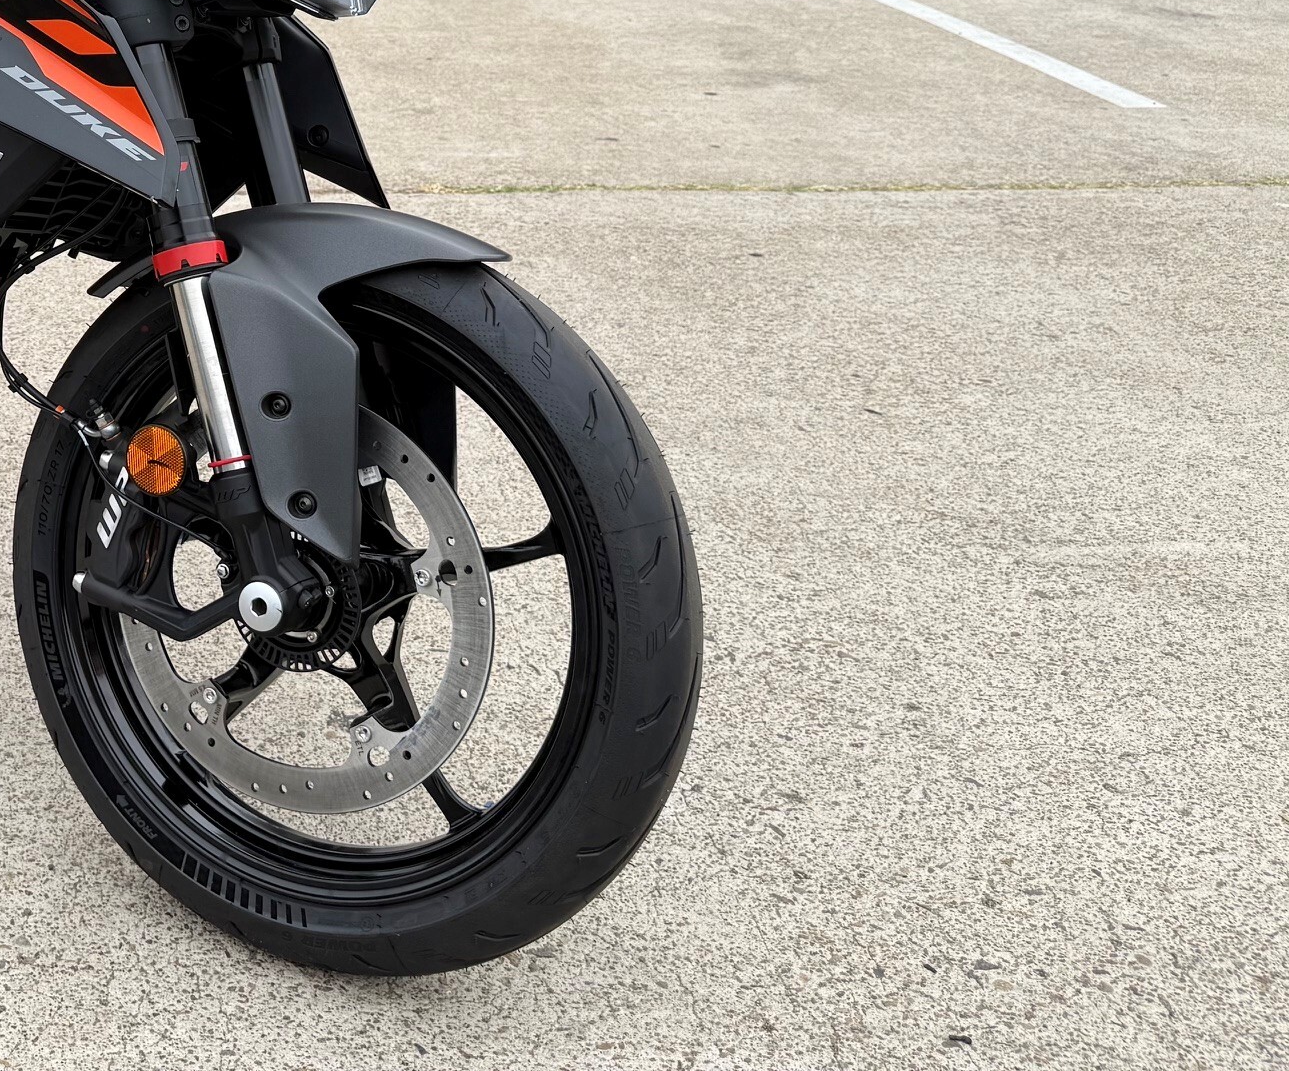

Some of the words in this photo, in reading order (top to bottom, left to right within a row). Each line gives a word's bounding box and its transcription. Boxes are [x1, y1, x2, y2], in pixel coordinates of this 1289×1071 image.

[37, 481, 53, 536] 110/70
[48, 460, 59, 481] ZR
[54, 439, 65, 457] 17
[35, 580, 64, 681] MICHELIN
[123, 807, 159, 840] FRONT
